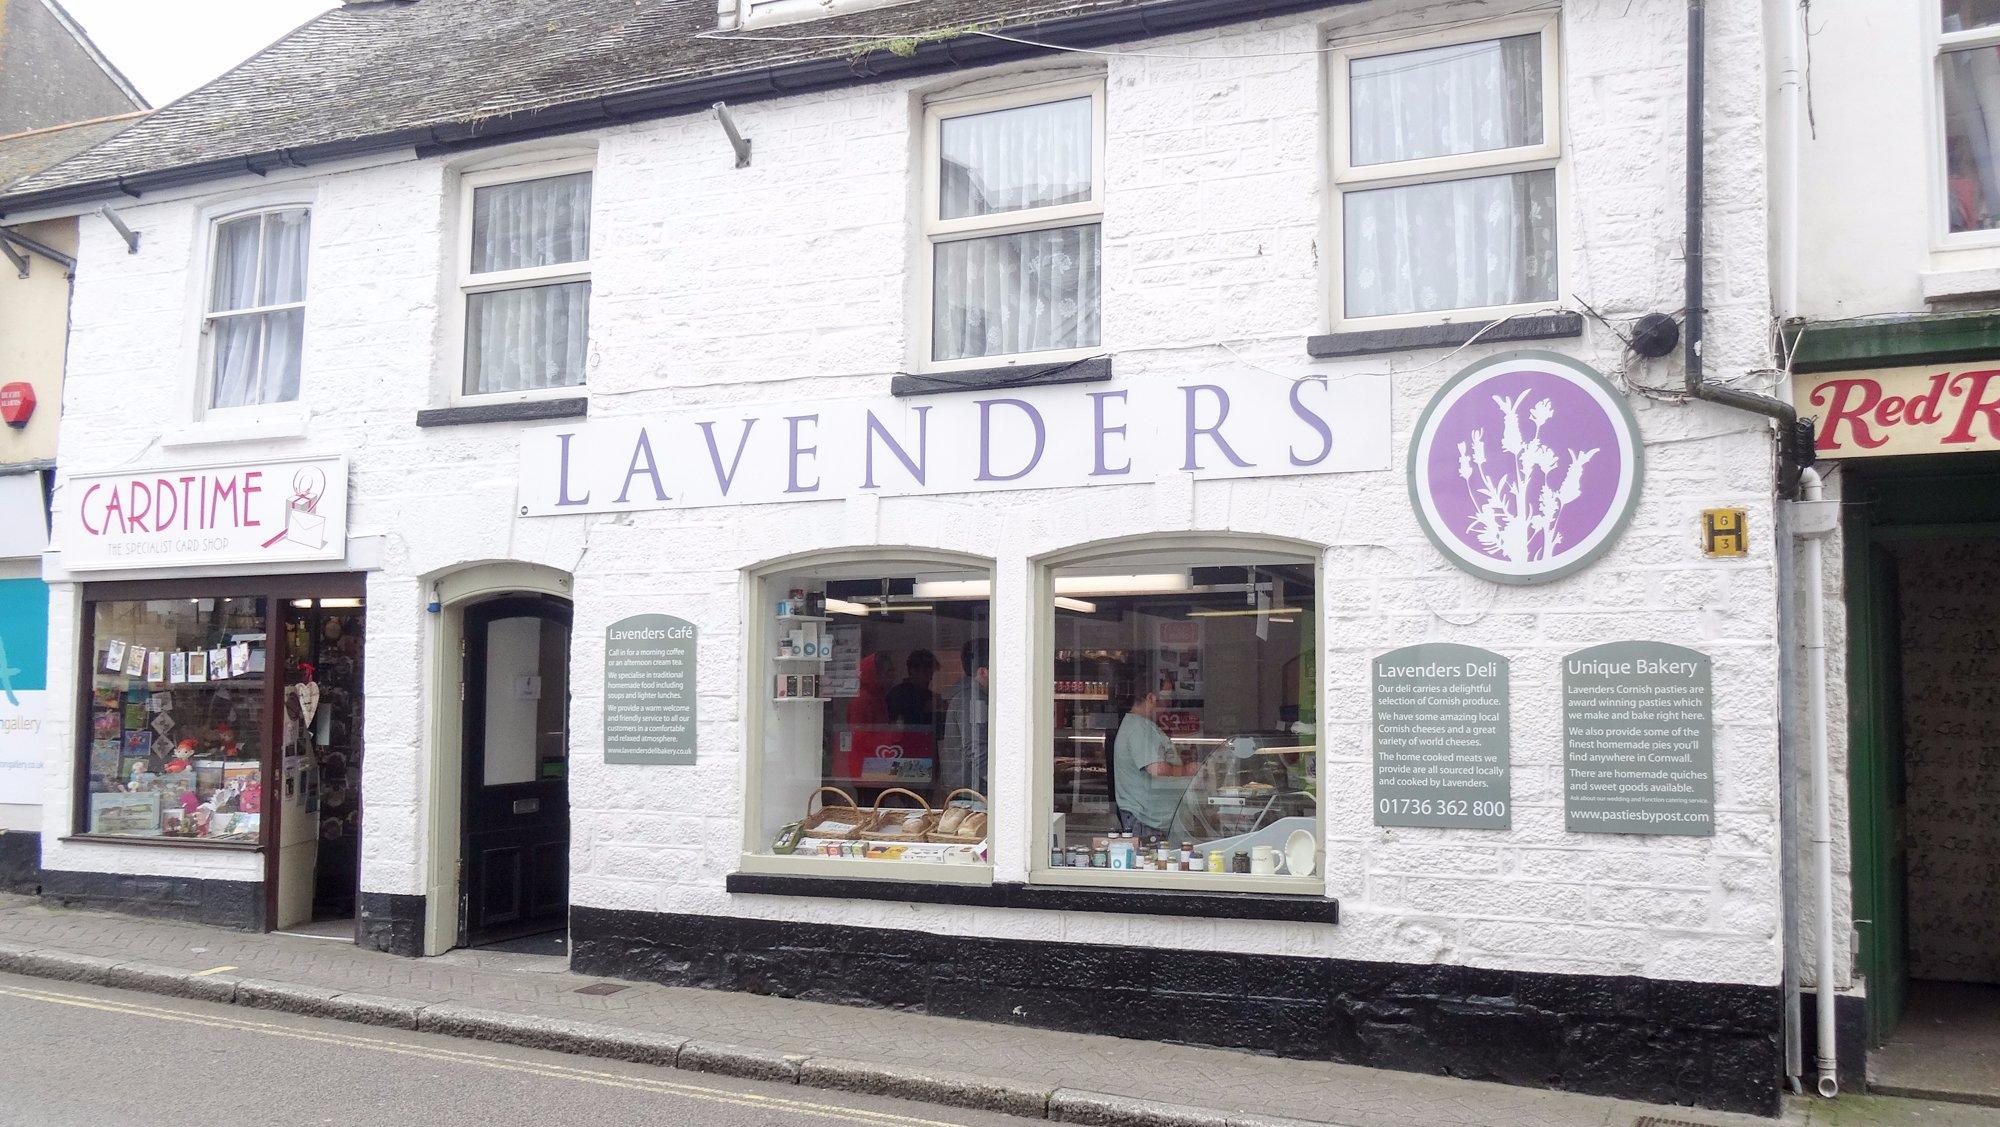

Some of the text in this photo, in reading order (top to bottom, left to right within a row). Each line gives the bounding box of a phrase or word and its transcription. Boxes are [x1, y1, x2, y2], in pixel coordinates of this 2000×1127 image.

[1809, 372, 1950, 450] Red
[553, 374, 1334, 508] LAVENDERS
[81, 472, 262, 535] CARDTIME
[1720, 516, 1728, 525] 6
[108, 538, 228, 556] THE SPECIALIST CARD SHOP
[1721, 539, 1729, 549] 3
[610, 626, 692, 640] Lavenders Café
[641, 649, 665, 657] morning
[1379, 663, 1497, 677] Lavenders Deli
[1569, 659, 1697, 677] Unique Bakery
[618, 672, 645, 680] specialise
[656, 682, 683, 690] including
[1378, 685, 1394, 693] Our
[1396, 684, 1411, 693] deli
[1413, 685, 1440, 693] carries
[1449, 684, 1491, 694] delightful
[1568, 685, 1614, 694] Lavenders
[1616, 685, 1652, 694] Cornish
[1654, 685, 1687, 695] pasties
[638, 692, 656, 700] lighter
[1378, 697, 1501, 707] selection of Cornish produce.
[1568, 698, 1702, 708] award winning pasties which
[618, 705, 640, 713] provide
[620, 715, 641, 723] friendly
[1440, 713, 1476, 723] amazing
[1479, 713, 1499, 721] local
[1584, 711, 1609, 719] make
[1611, 711, 1629, 719] and
[1631, 711, 1654, 719] bake
[1657, 711, 1679, 721] right
[1681, 711, 1704, 720] here.
[1378, 725, 1410, 733] Cornish
[1412, 725, 1446, 733] cheeses
[1447, 725, 1464, 733] and
[1473, 726, 1496, 735] great
[1569, 727, 1583, 735] We
[1585, 727, 1604, 736] also
[1606, 728, 1641, 737] provide
[1672, 727, 1683, 736] of
[1683, 727, 1699, 736] the
[641, 735, 677, 743] atmosphere.
[1378, 737, 1481, 746] variety of world cheeses.
[1569, 740, 1698, 751] finest homemade pies you'll
[1379, 752, 1394, 761] The
[1396, 753, 1420, 761] home
[1422, 753, 1454, 762] cooked
[1456, 754, 1482, 762] meats
[1569, 753, 1692, 764] find anywhere in Cornwall.
[1379, 765, 1411, 775] provide
[1428, 766, 1438, 774] all
[1476, 767, 1504, 777] locally
[1570, 769, 1595, 777] There
[1614, 770, 1669, 778] homemade
[1670, 771, 1707, 781] quiches
[1397, 778, 1428, 786] cooked
[1430, 778, 1440, 788] by
[1442, 779, 1488, 788] Lavenders.
[1590, 783, 1617, 791] sweet
[1619, 783, 1648, 792] goods
[1650, 783, 1694, 792] available.
[1380, 799, 1505, 817] 01736 362 800
[1571, 810, 1709, 822] www.pastiesbypost.com
